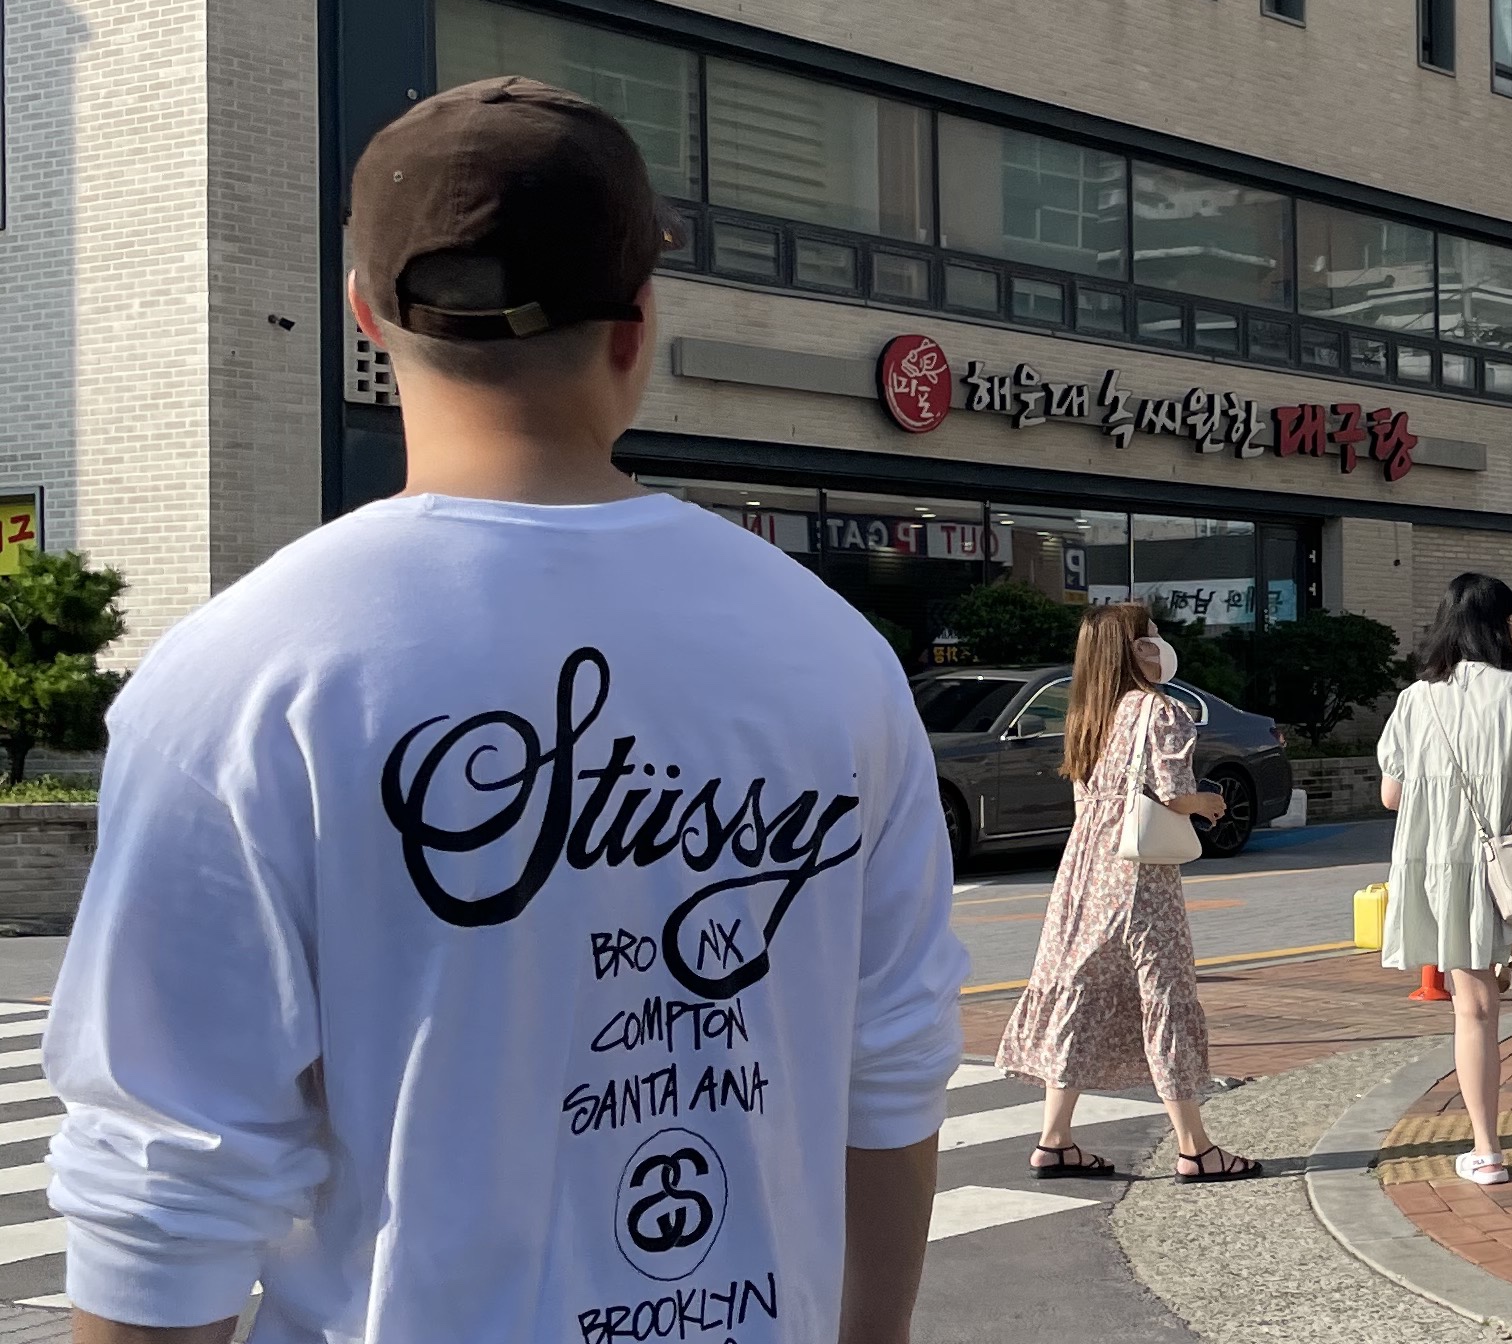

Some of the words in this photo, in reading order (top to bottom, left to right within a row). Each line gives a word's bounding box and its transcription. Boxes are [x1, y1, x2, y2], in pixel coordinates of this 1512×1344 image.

[963, 360, 1089, 429] 해운대
[1272, 403, 1419, 482] 대구탕
[381, 647, 863, 999] Stüssy
[590, 995, 749, 1053] COMPTON
[562, 1062, 678, 1135] SANTA
[688, 1061, 769, 1115] ANA
